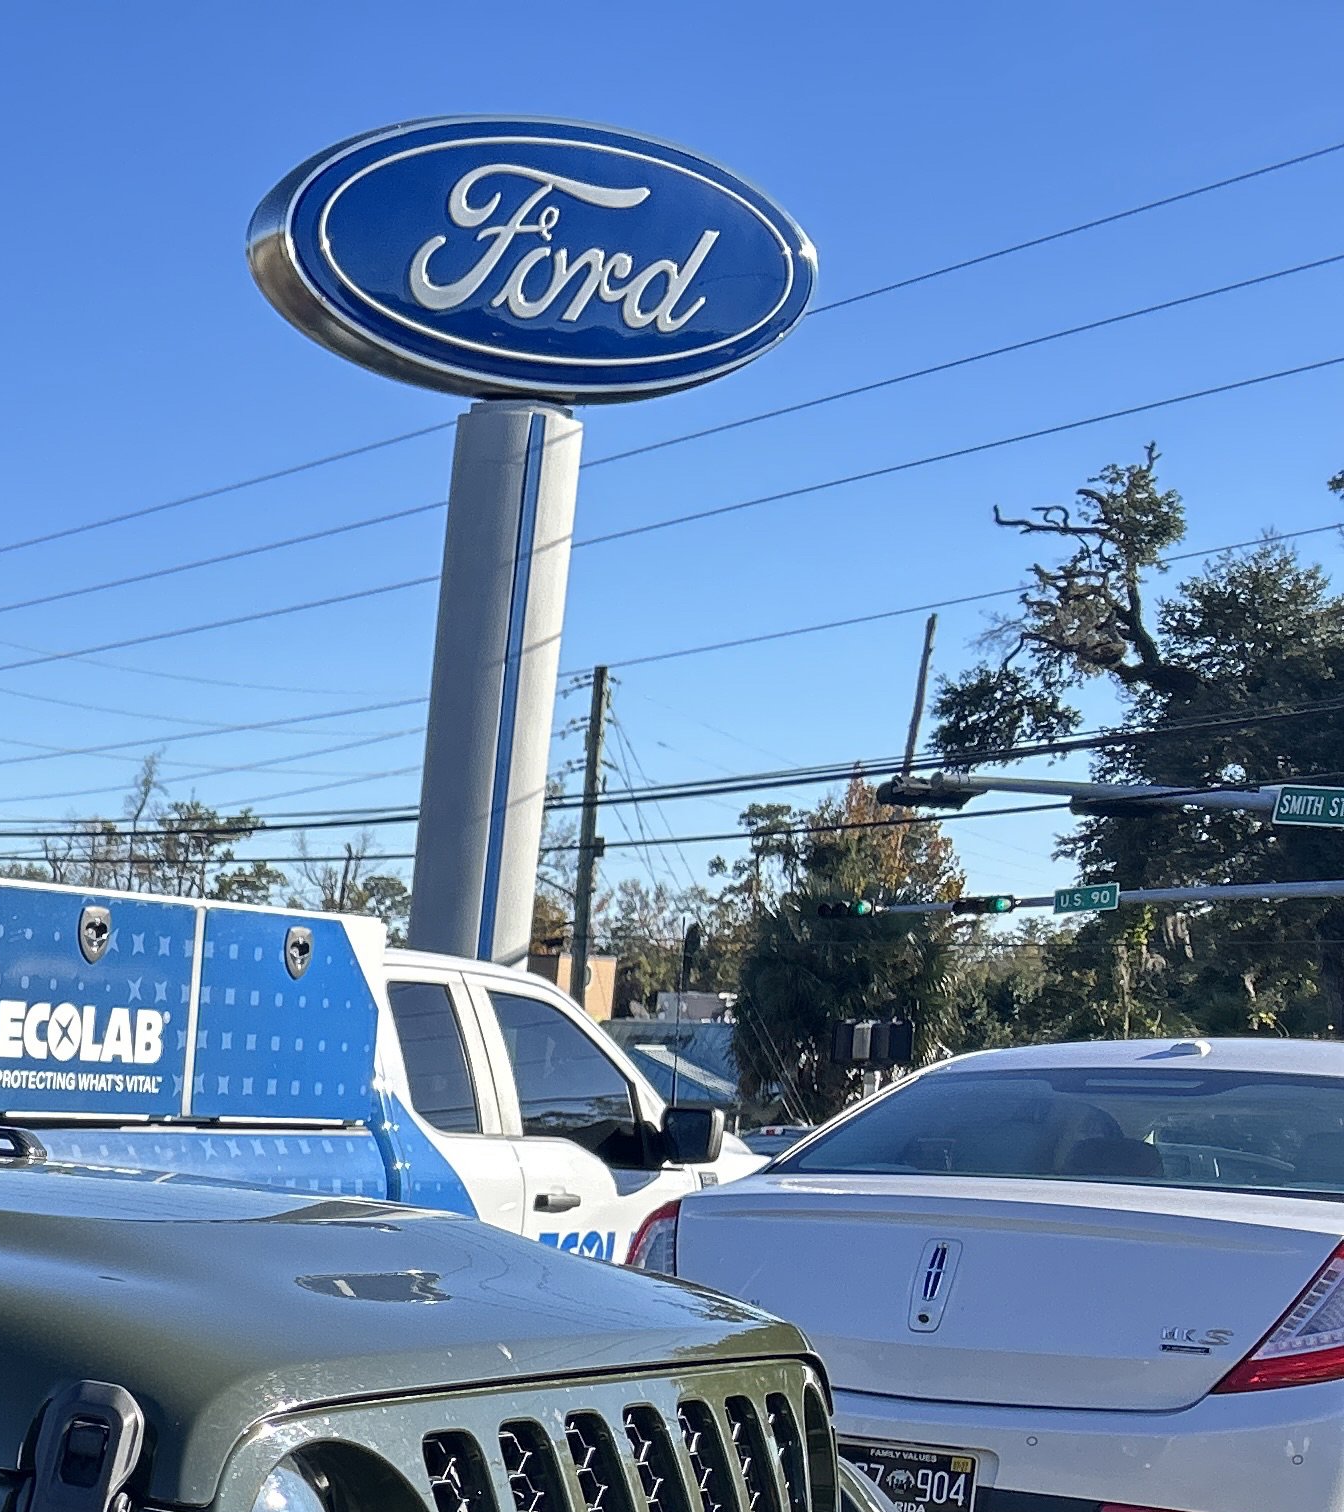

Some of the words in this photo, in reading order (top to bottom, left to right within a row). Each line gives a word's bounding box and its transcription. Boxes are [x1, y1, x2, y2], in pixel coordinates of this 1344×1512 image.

[410, 164, 720, 333] Ford
[1279, 794, 1325, 816] SMITH
[1091, 890, 1110, 904] 90
[77, 1072, 124, 1092] WHAT'S
[870, 1448, 901, 1459] FAMILY
[902, 1451, 937, 1463] VALUES
[915, 1469, 966, 1507] 904
